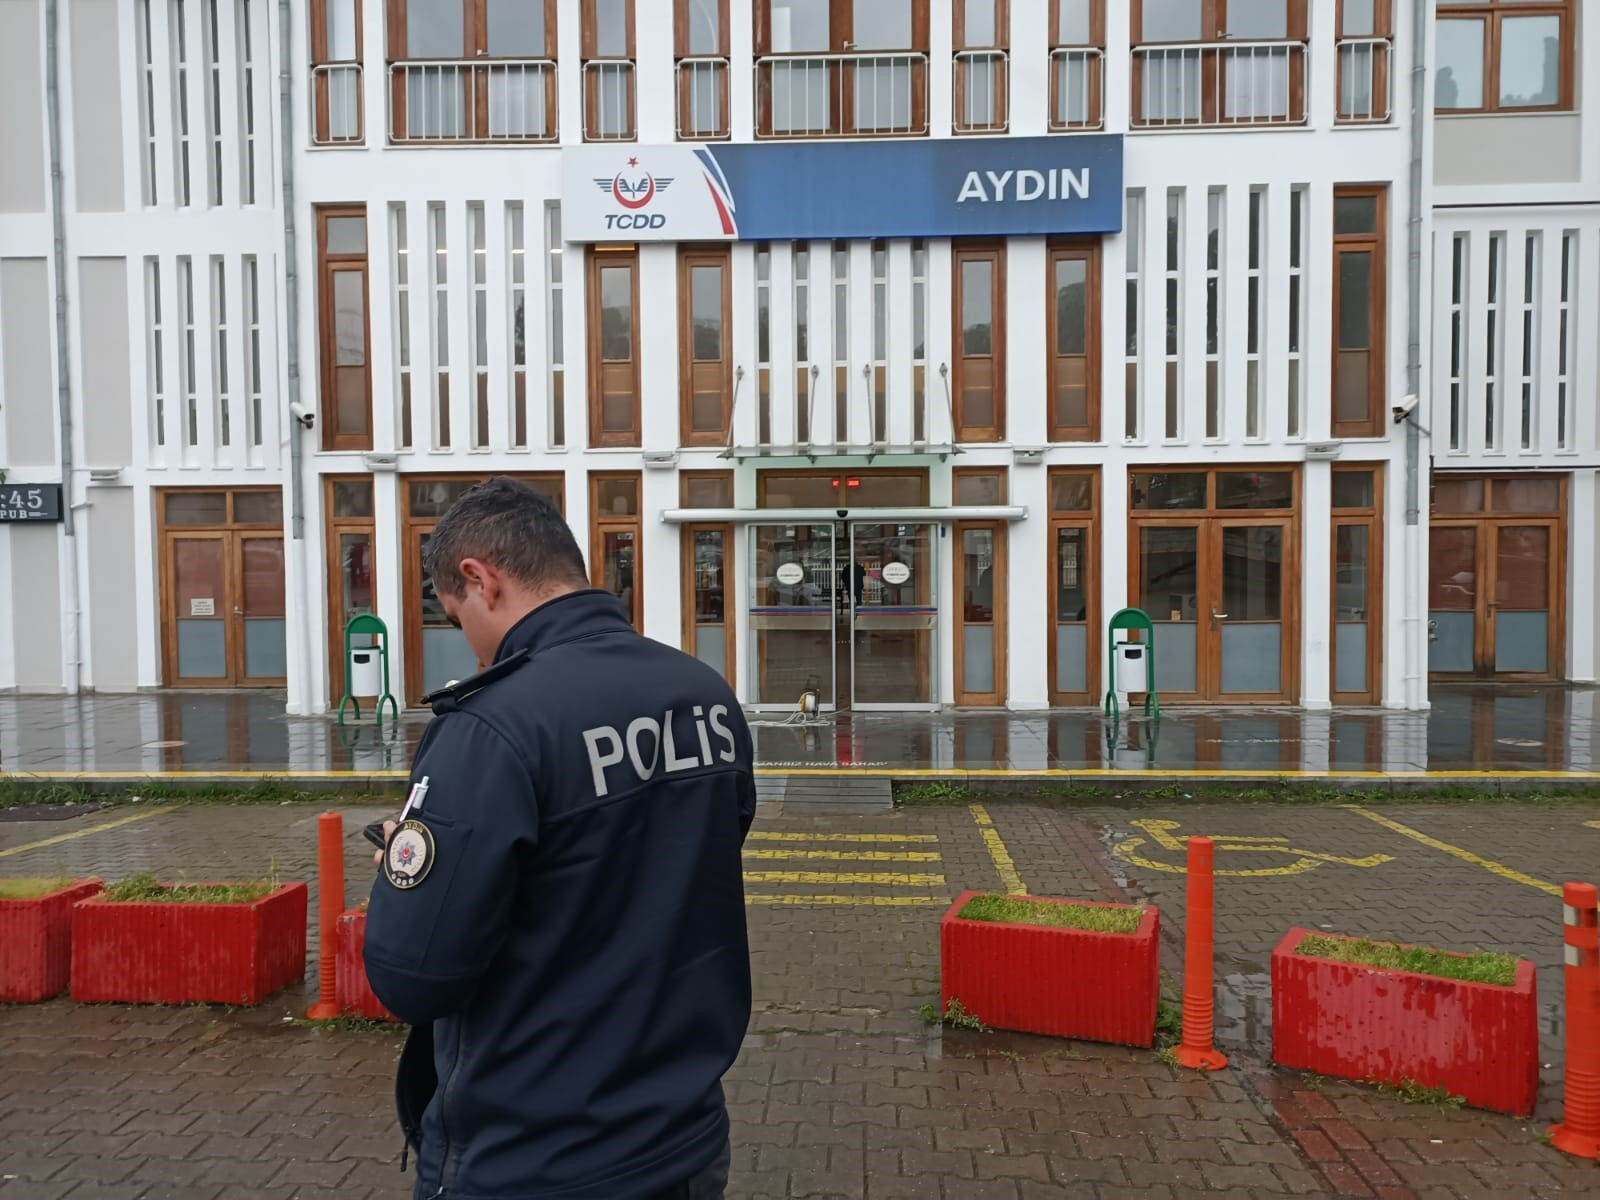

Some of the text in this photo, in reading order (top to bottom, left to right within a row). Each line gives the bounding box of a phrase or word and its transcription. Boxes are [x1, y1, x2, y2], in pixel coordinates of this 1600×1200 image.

[956, 168, 1090, 202] AYDIN
[604, 214, 666, 229] TCDD
[0, 510, 28, 519] PUB
